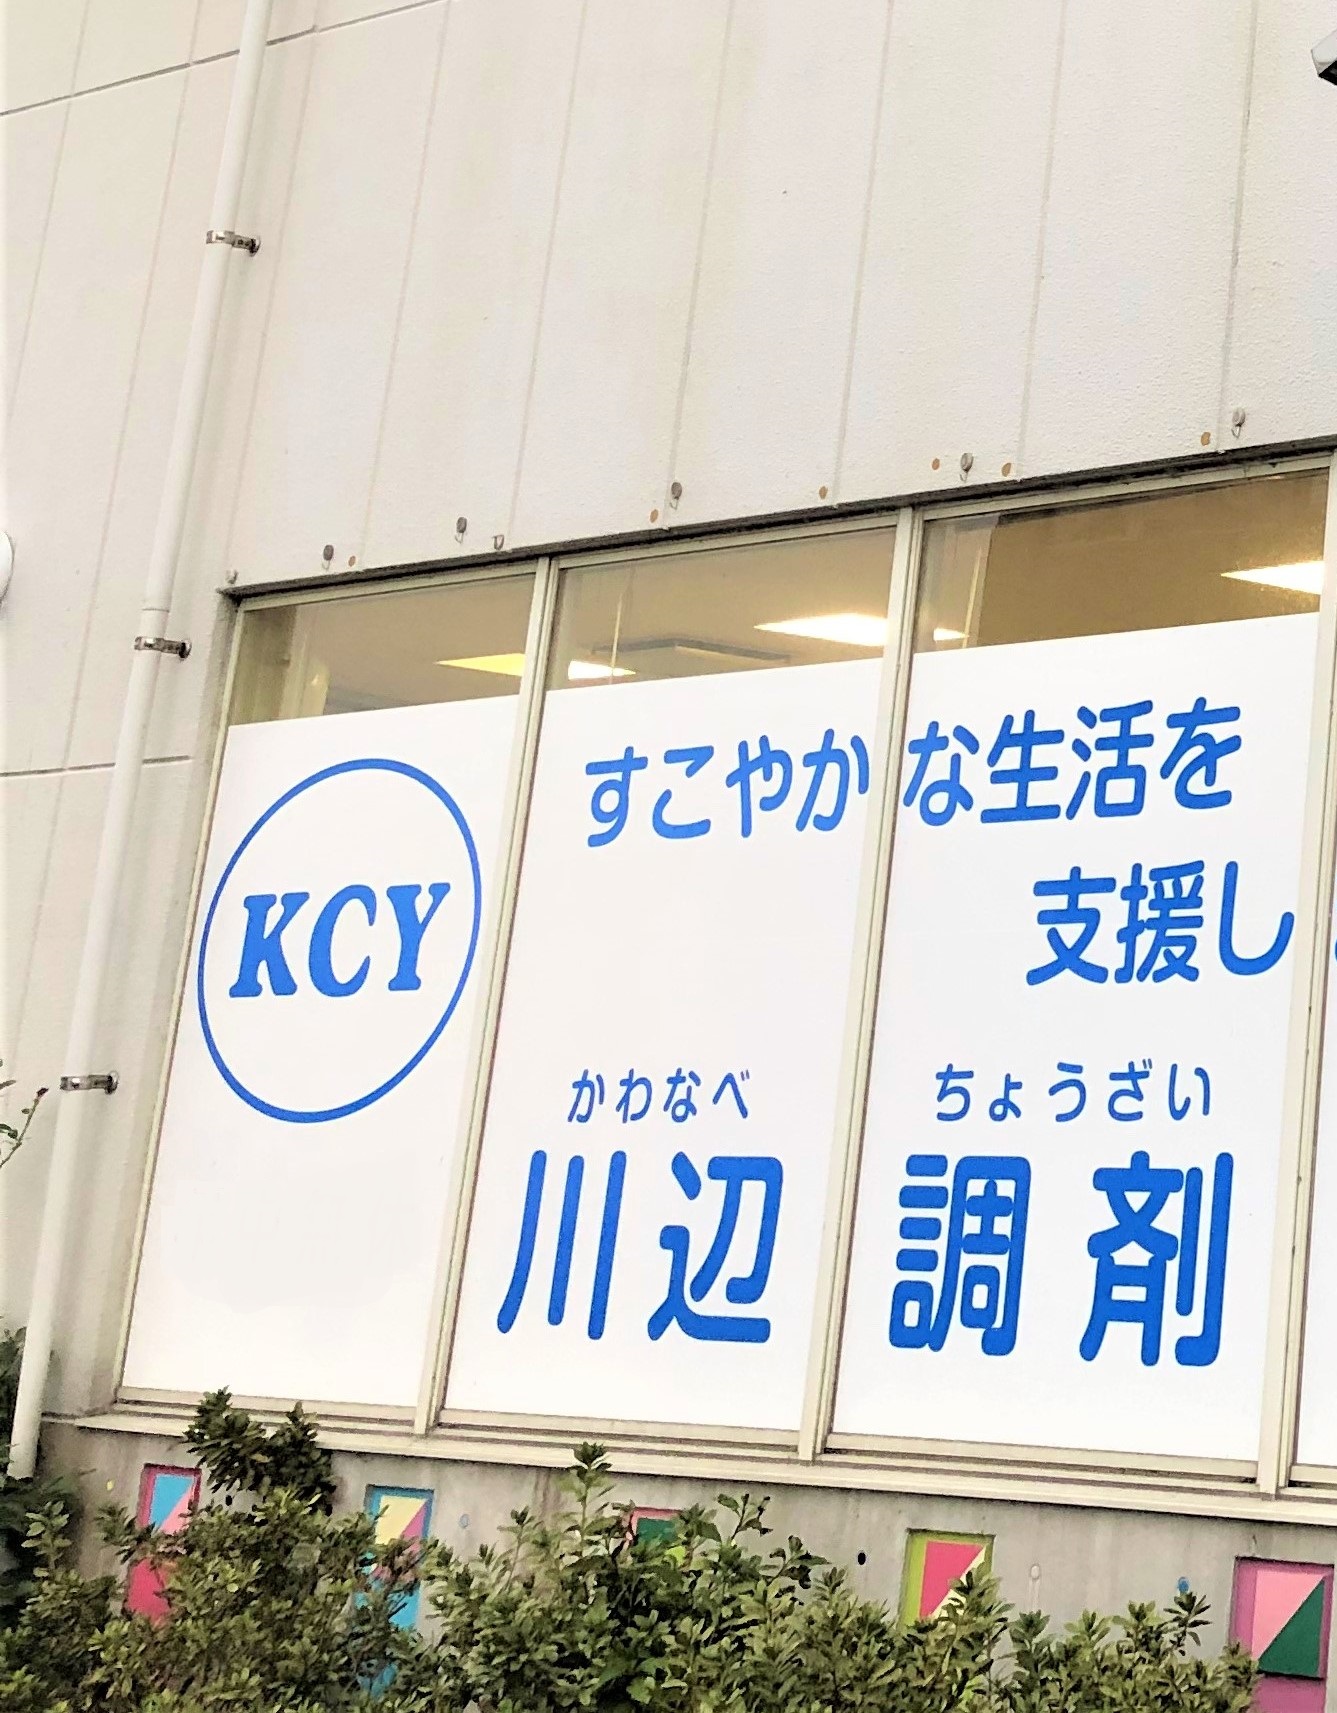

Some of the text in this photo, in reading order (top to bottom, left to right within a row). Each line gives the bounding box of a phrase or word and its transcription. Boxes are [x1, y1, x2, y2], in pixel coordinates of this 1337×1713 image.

[229, 882, 450, 998] KCY
[568, 1068, 752, 1124] かわなべ
[935, 1058, 1211, 1124] ちょうざい
